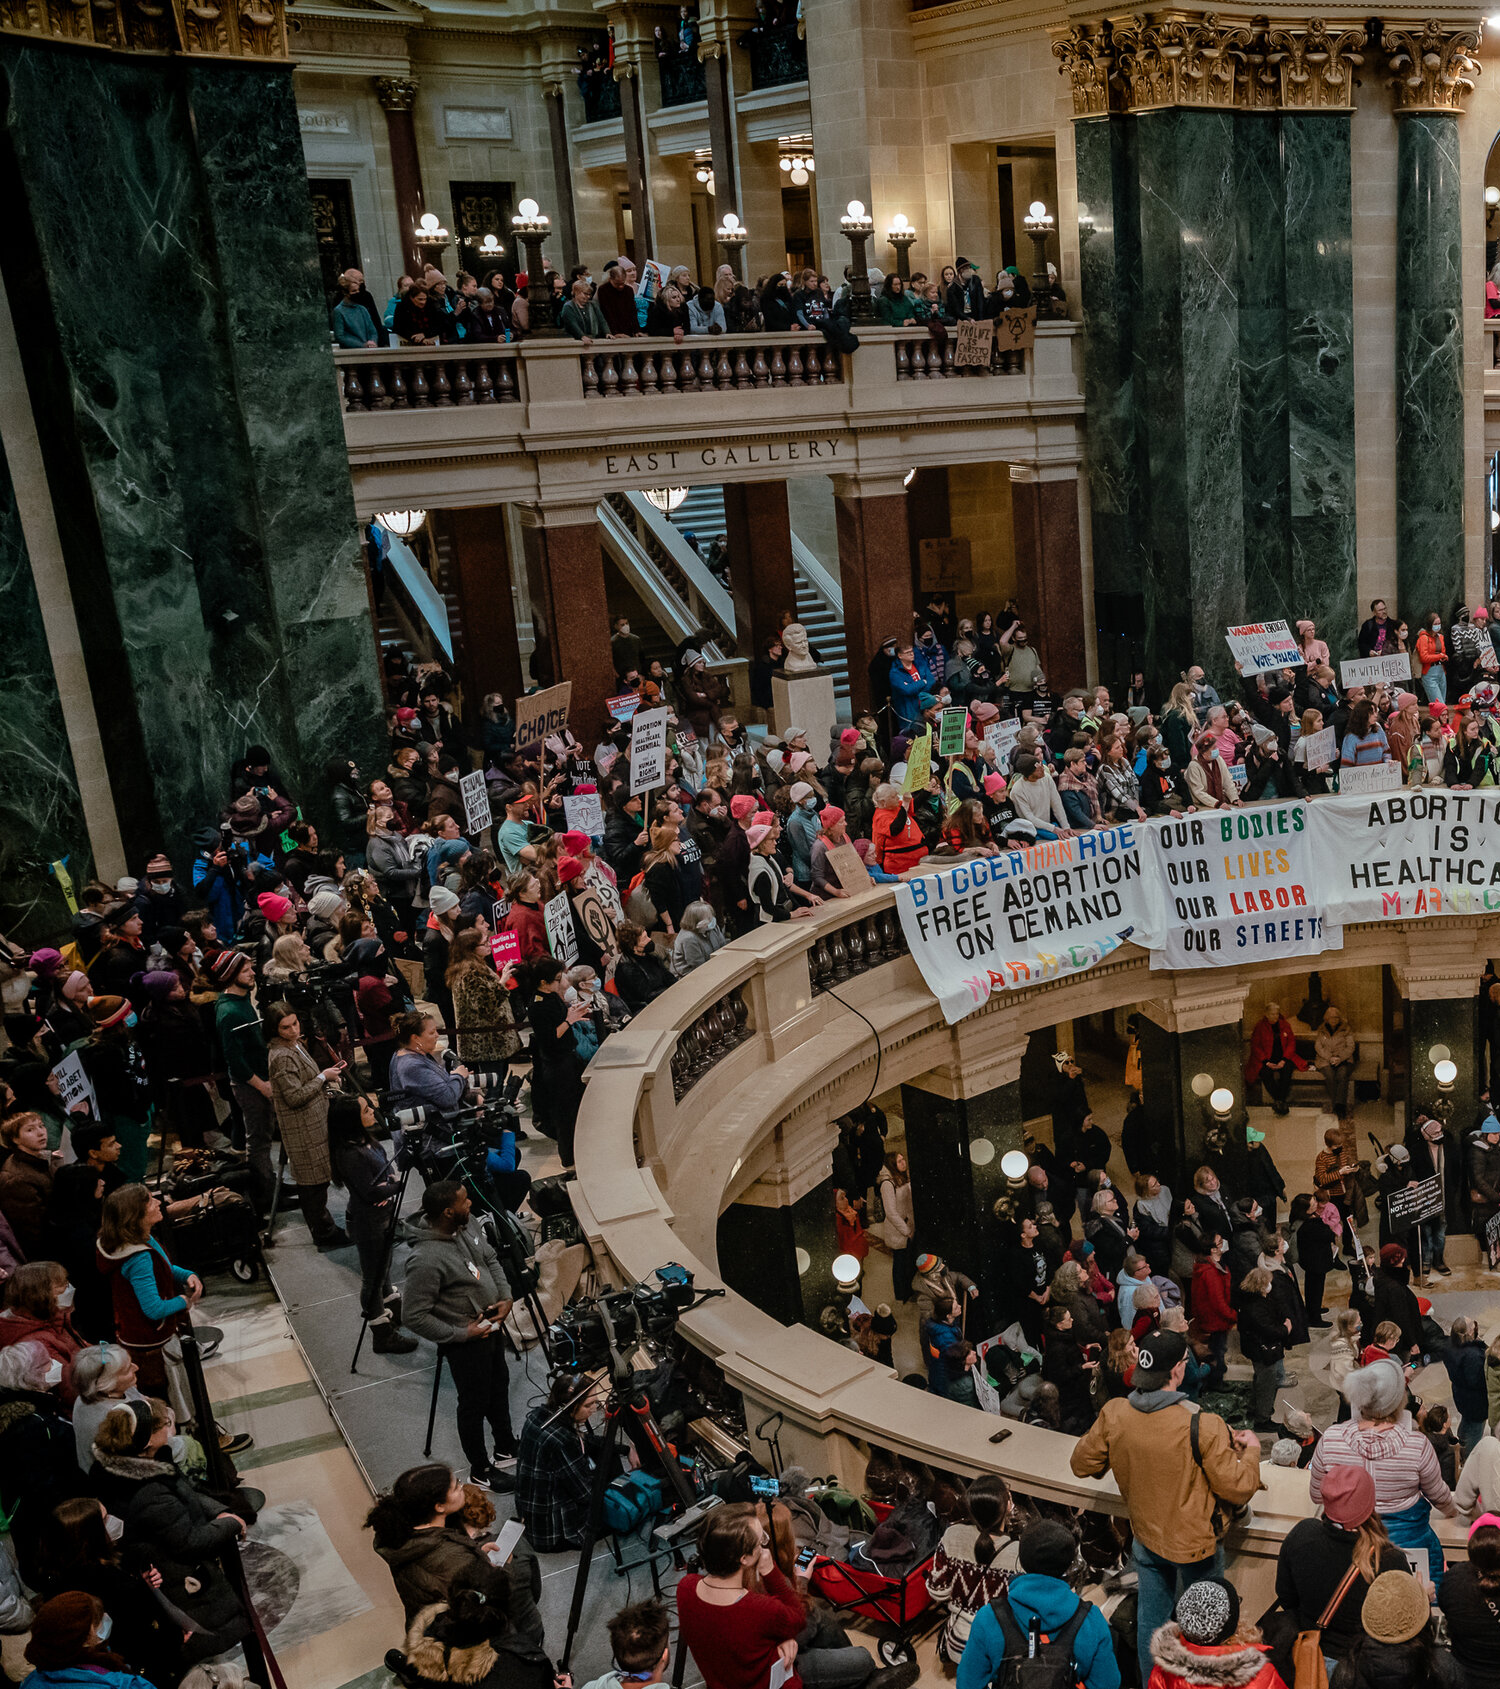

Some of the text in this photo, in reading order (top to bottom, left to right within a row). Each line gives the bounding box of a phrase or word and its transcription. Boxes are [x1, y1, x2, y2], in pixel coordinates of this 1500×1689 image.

[606, 438, 840, 474] EAST GALLERY
[1360, 659, 1407, 678] WITH HER
[637, 720, 662, 734] ABORTION
[576, 760, 591, 771] VOTE
[1160, 808, 1304, 849] OUR BODIES
[1434, 825, 1469, 852] IS
[908, 824, 1136, 908] BIGGER THAN ROE
[1167, 848, 1290, 885] OUR LIVES
[549, 895, 566, 915] BUILD
[916, 850, 1141, 942] FREE ABORTION
[1175, 885, 1307, 920] OUR LABOR
[547, 906, 571, 928] THIS WALL
[956, 890, 1122, 960] ON DEMAND
[492, 934, 509, 945] Abortion
[493, 941, 516, 953] Health Care
[1184, 917, 1323, 951] OUR STREETS
[66, 1069, 83, 1089] ABET
